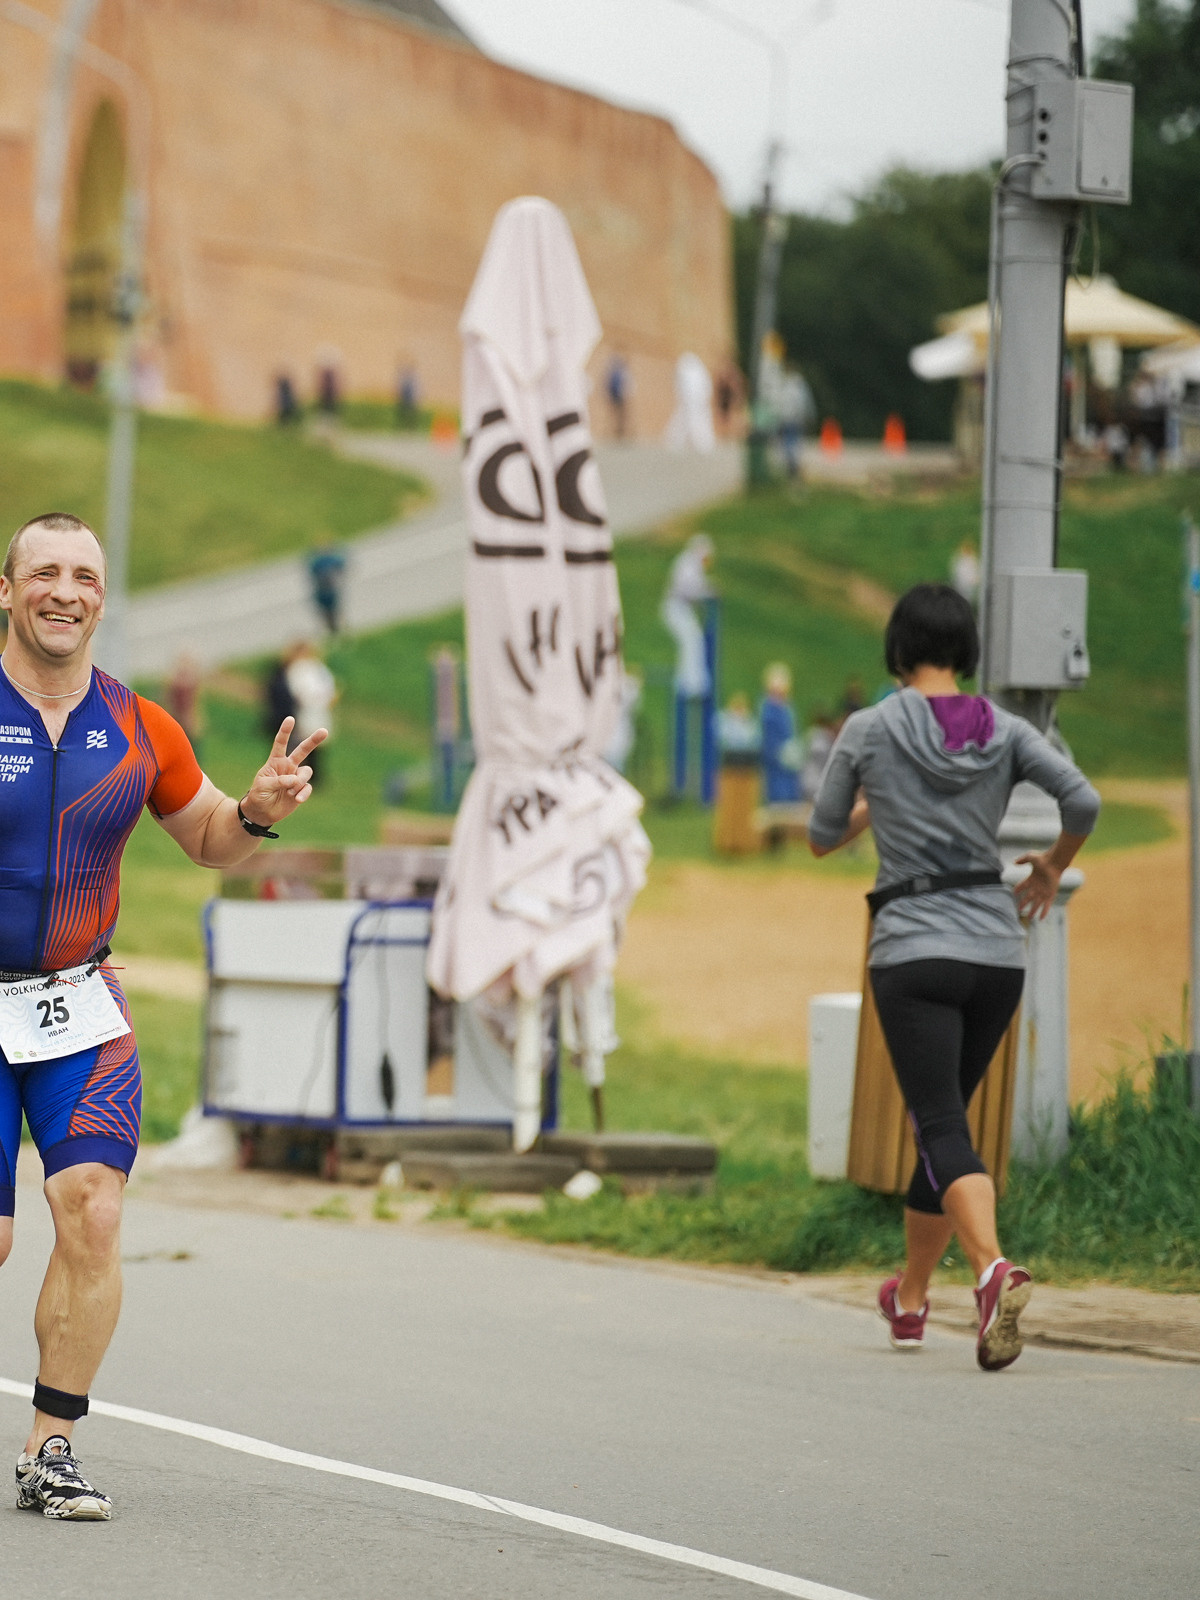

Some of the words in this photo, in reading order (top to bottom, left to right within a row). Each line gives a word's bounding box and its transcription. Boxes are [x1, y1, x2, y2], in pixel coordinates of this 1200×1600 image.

[68, 974, 86, 984] 2023
[36, 996, 70, 1028] 25
[47, 1027, 69, 1038] ИВАН
